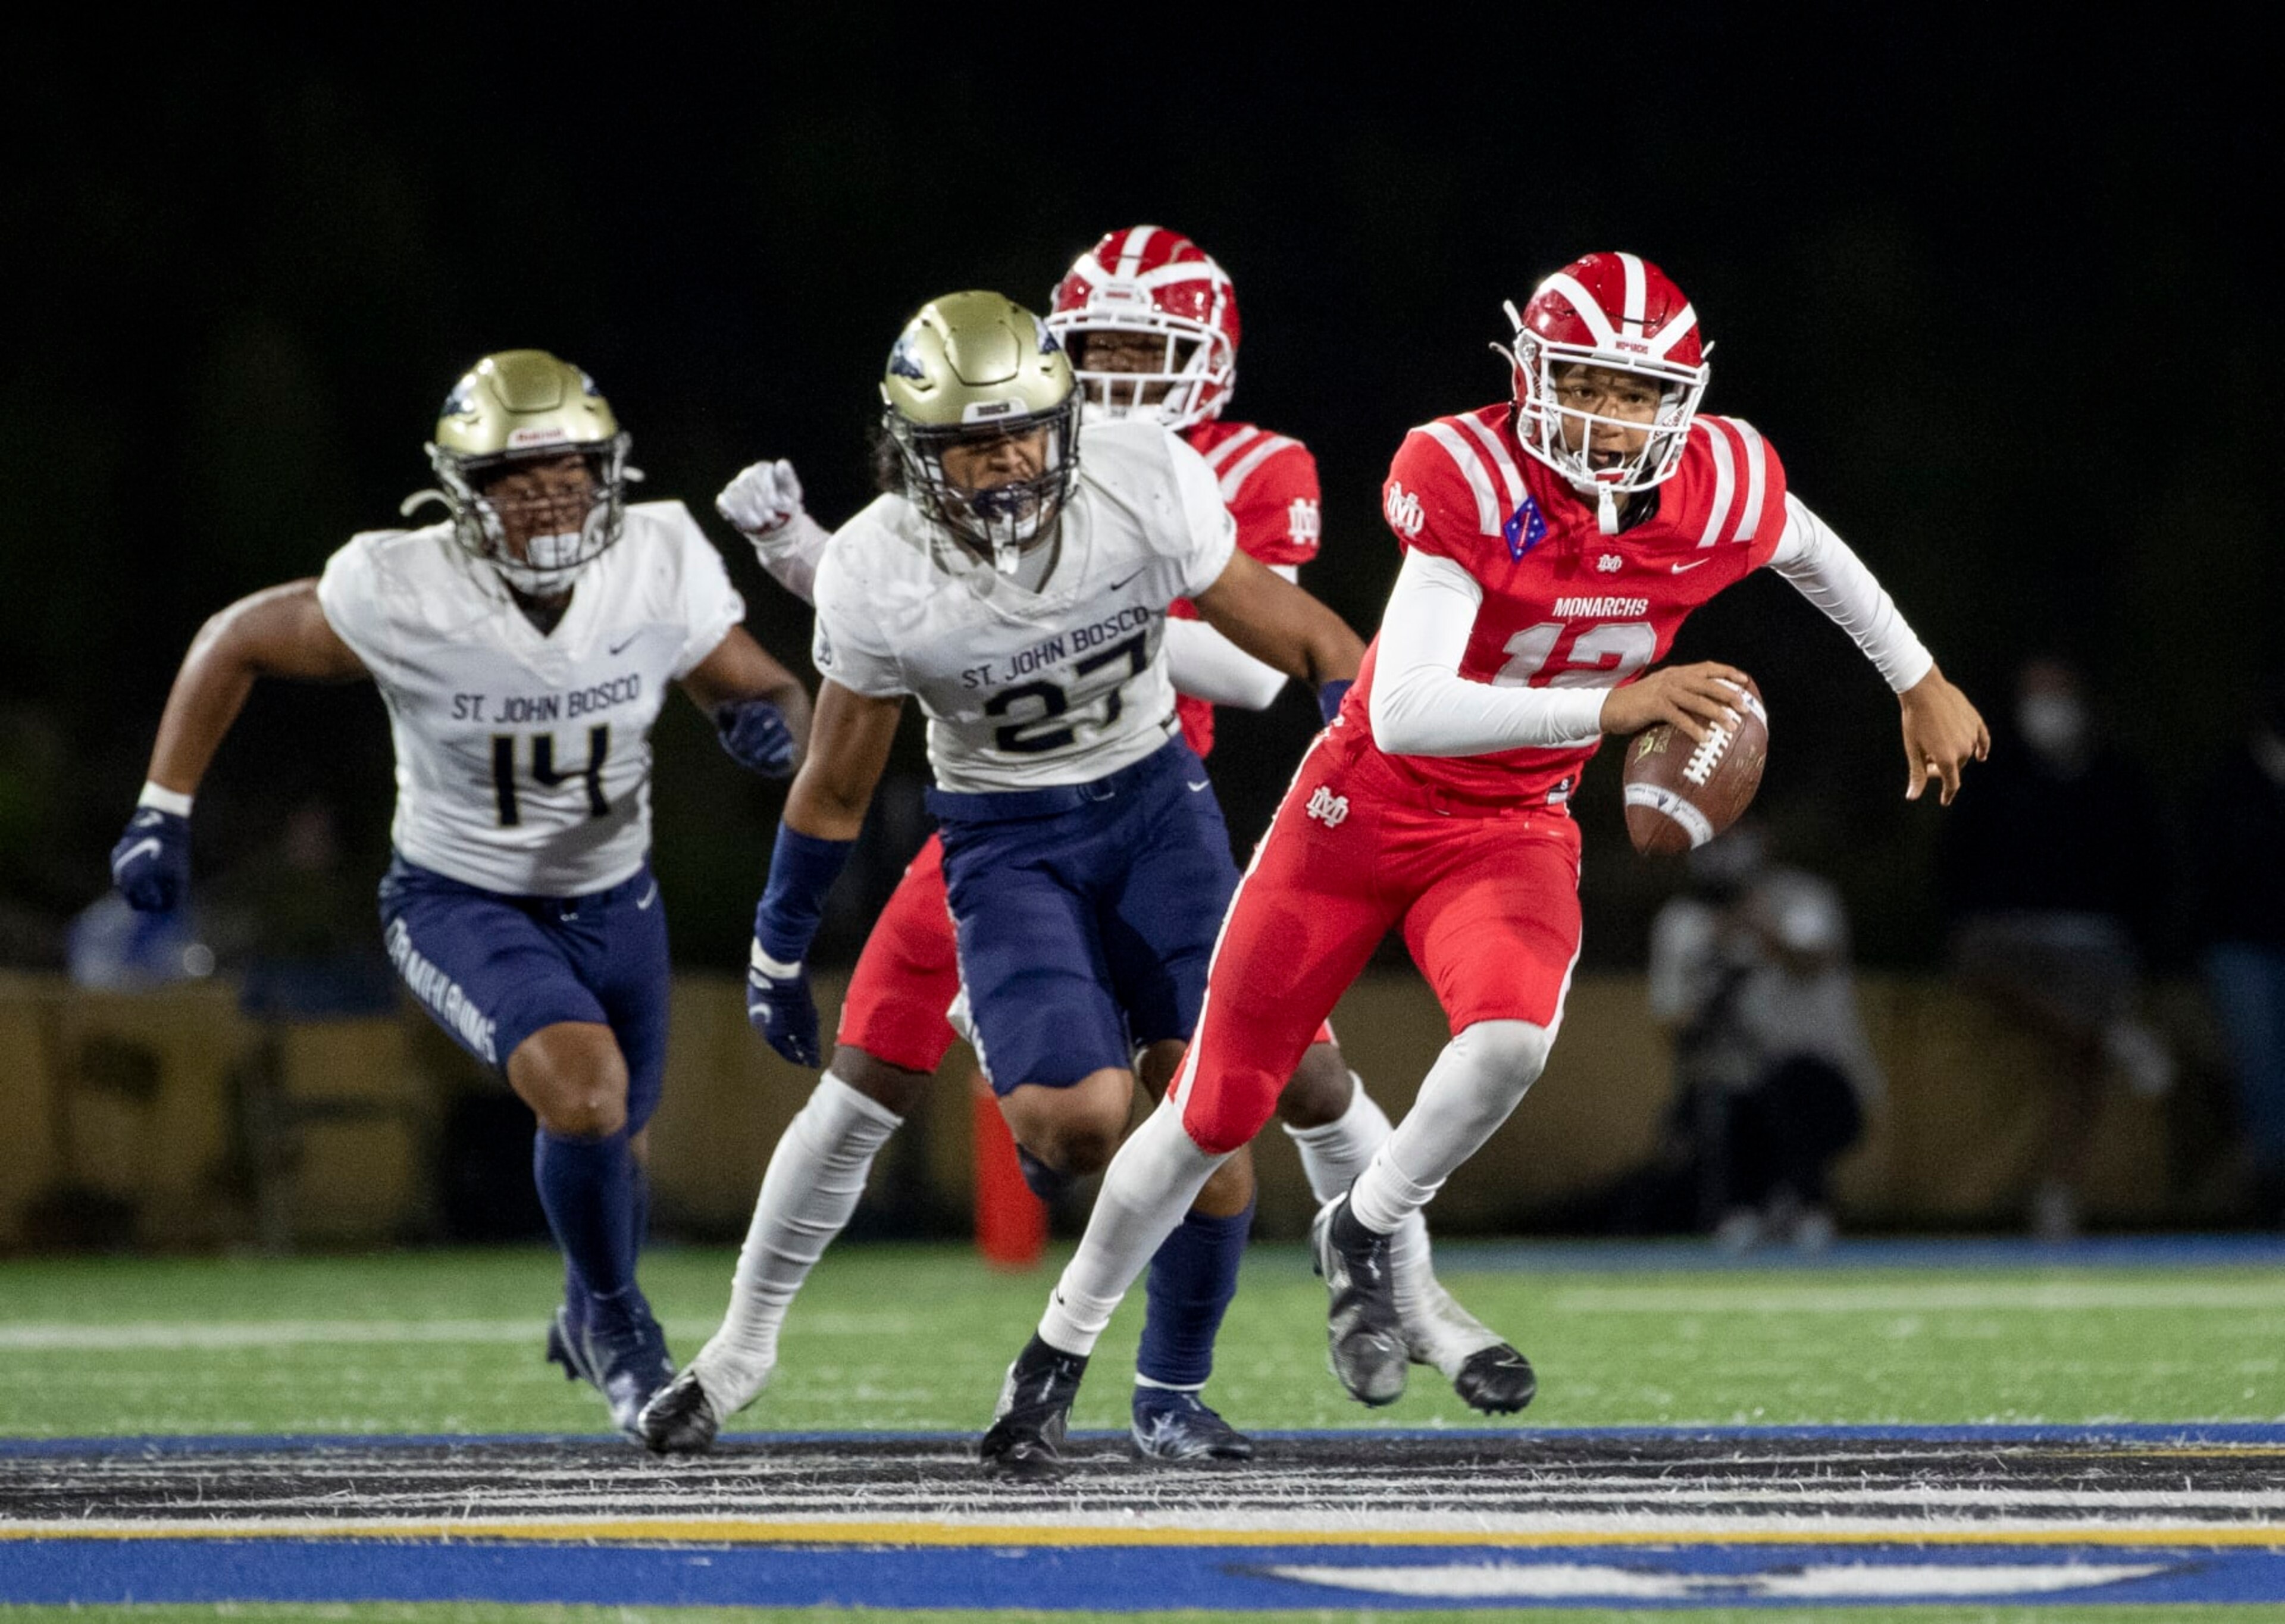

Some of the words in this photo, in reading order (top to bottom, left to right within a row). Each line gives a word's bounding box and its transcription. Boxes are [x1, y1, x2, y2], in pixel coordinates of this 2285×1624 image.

[1006, 637, 1066, 681] JOHN
[1071, 605, 1149, 653] BOSCO
[1552, 597, 1648, 617] MONARCHS
[494, 695, 560, 723] JOHN
[568, 674, 640, 718] BOSCO
[984, 628, 1147, 753] 27
[491, 723, 610, 828] 14
